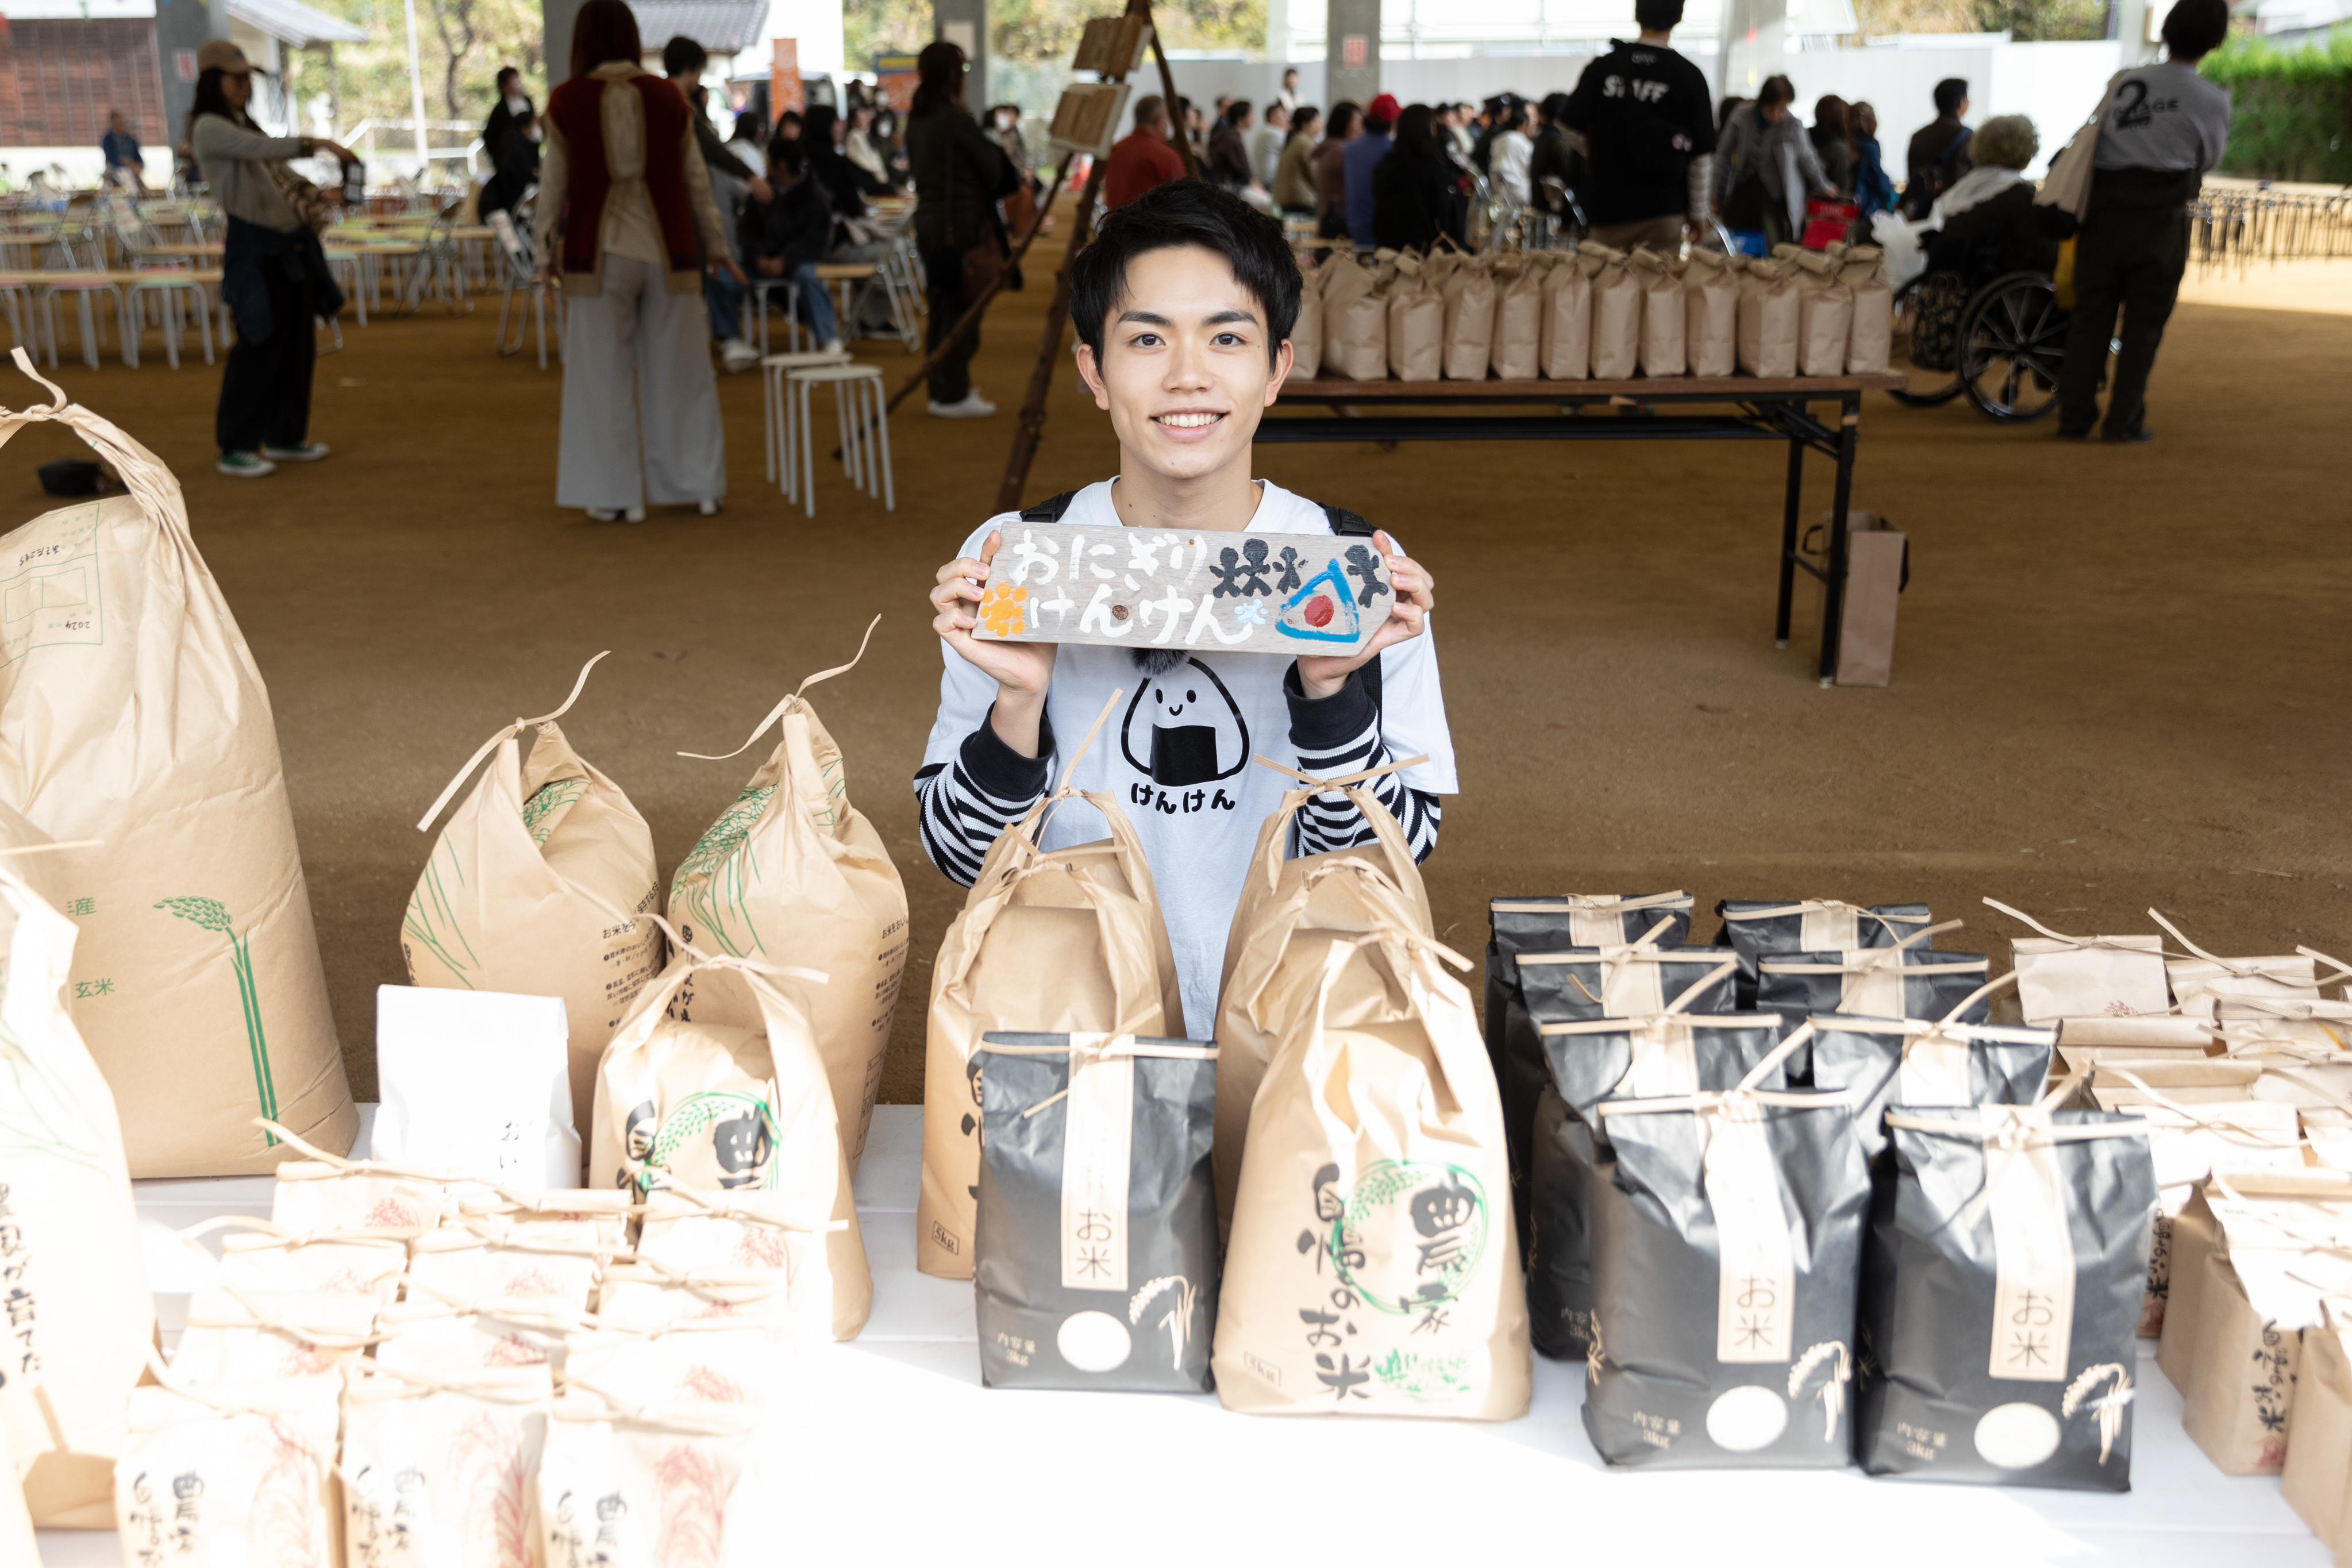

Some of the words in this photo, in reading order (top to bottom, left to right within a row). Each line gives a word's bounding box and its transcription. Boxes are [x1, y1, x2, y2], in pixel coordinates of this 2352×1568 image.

[2116, 79, 2150, 129] 2
[20, 545, 60, 566] あきたこまち
[1009, 528, 1207, 591] おにぎり
[65, 620, 91, 630] 2024
[1031, 584, 1254, 645] けんけん
[1130, 782, 1235, 814] けんけん
[75, 977, 115, 999] 玄米
[935, 1227, 954, 1253] 5kg
[1077, 1207, 1111, 1278] お米
[1735, 1272, 1776, 1350] お米
[2007, 1288, 2054, 1367] お米
[998, 1331, 1035, 1354] 内容量
[1006, 1349, 1029, 1367] 3kg
[1633, 1411, 1680, 1436] 内容量
[1643, 1428, 1670, 1449] 3kg
